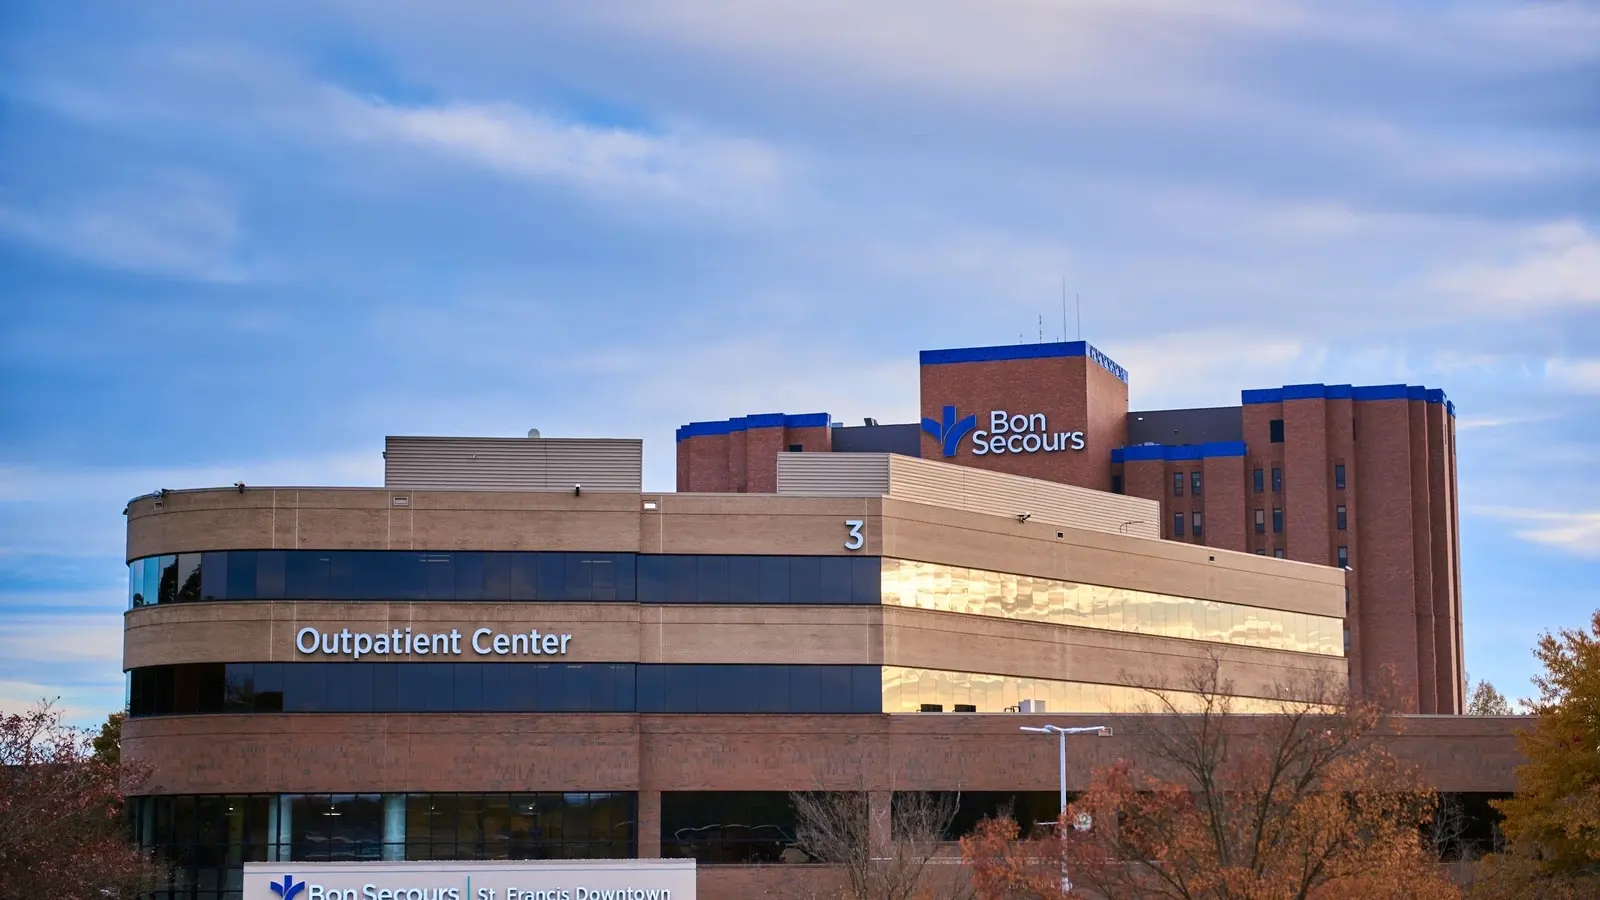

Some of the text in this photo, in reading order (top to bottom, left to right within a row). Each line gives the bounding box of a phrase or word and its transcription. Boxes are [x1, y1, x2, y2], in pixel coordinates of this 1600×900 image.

[990, 410, 1046, 434] Bon
[972, 430, 1085, 455] Secours
[844, 519, 864, 550] 3
[296, 627, 572, 658] Outpatient Center
[308, 884, 357, 900] Bon
[362, 883, 460, 900] Secours
[507, 886, 570, 900] Francis
[576, 886, 671, 900] Downtown
